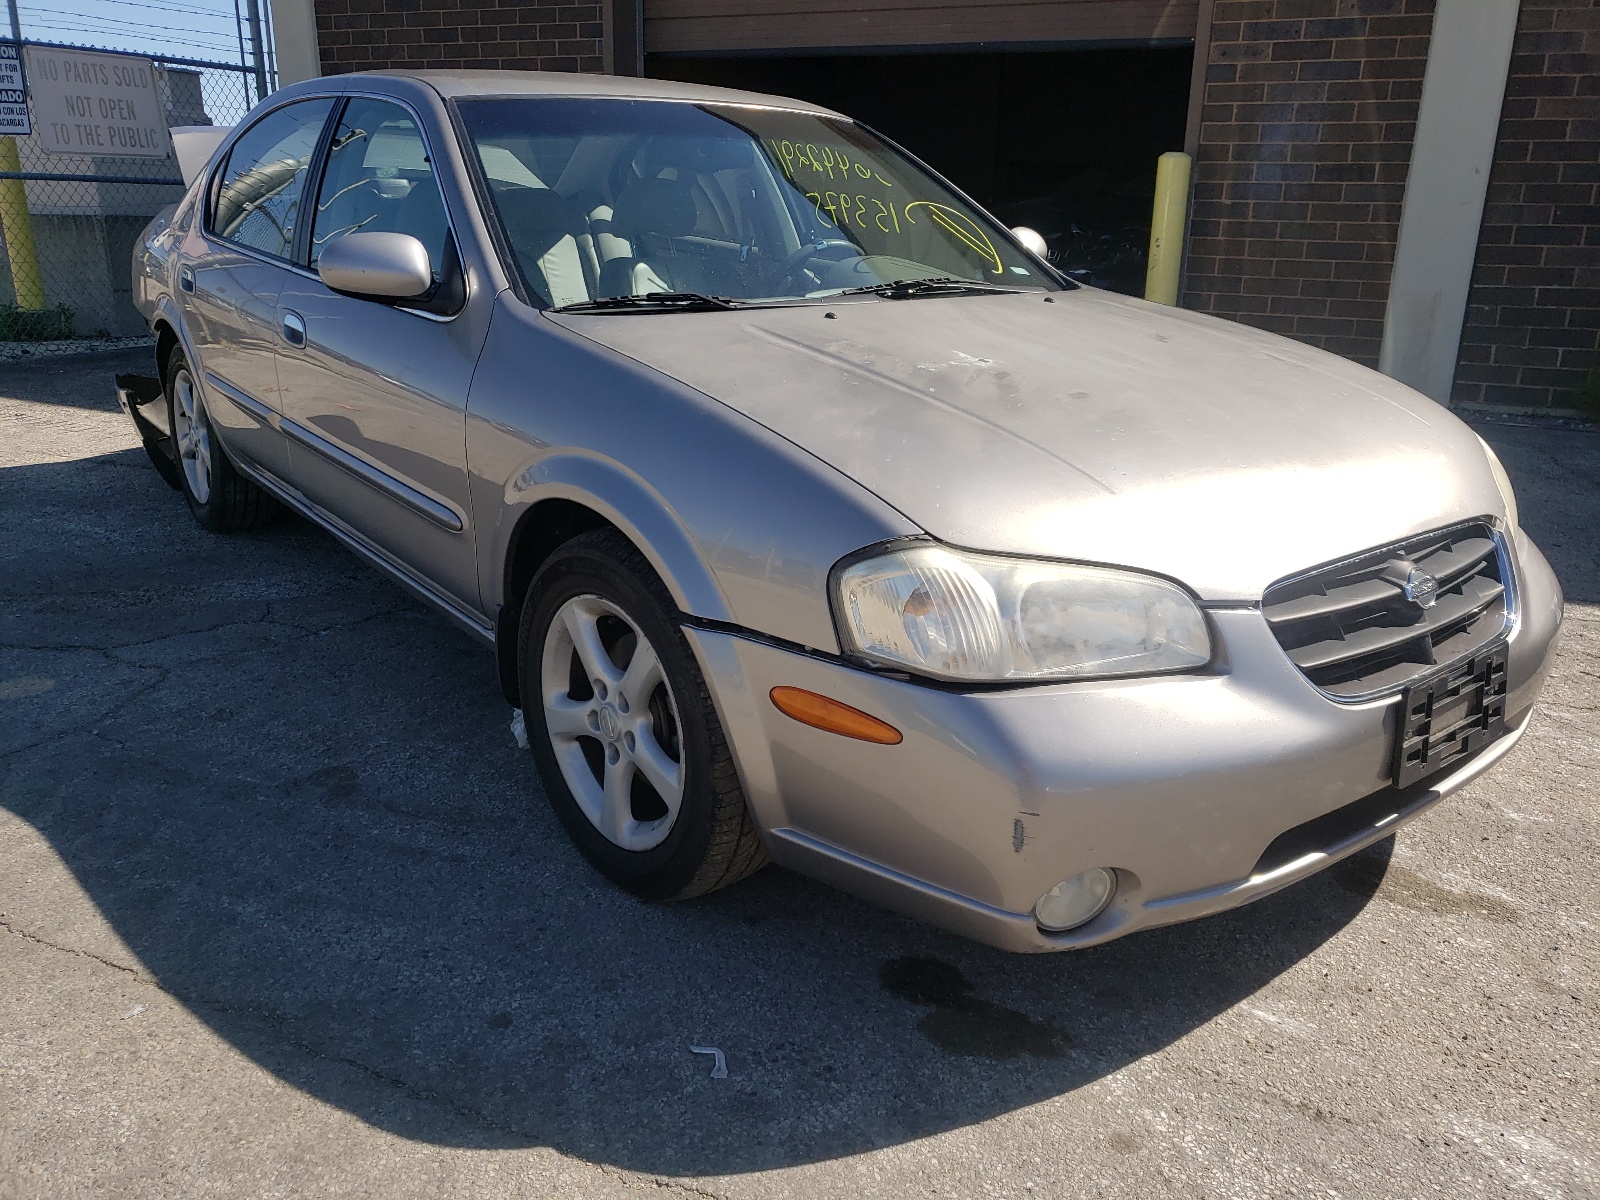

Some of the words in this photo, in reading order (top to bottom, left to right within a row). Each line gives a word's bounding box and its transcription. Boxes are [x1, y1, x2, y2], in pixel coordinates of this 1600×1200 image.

[0, 46, 17, 59] ON
[4, 63, 18, 73] FOR
[36, 58, 59, 81] NO
[63, 60, 109, 86] PARTS
[112, 65, 149, 88] SOLD
[2, 106, 15, 116] CON
[15, 107, 26, 116] LOS
[64, 95, 93, 118] NOT
[99, 97, 137, 120] OPEN
[50, 122, 70, 145] TO
[74, 123, 104, 147] THE
[107, 125, 159, 149] PUBLIC
